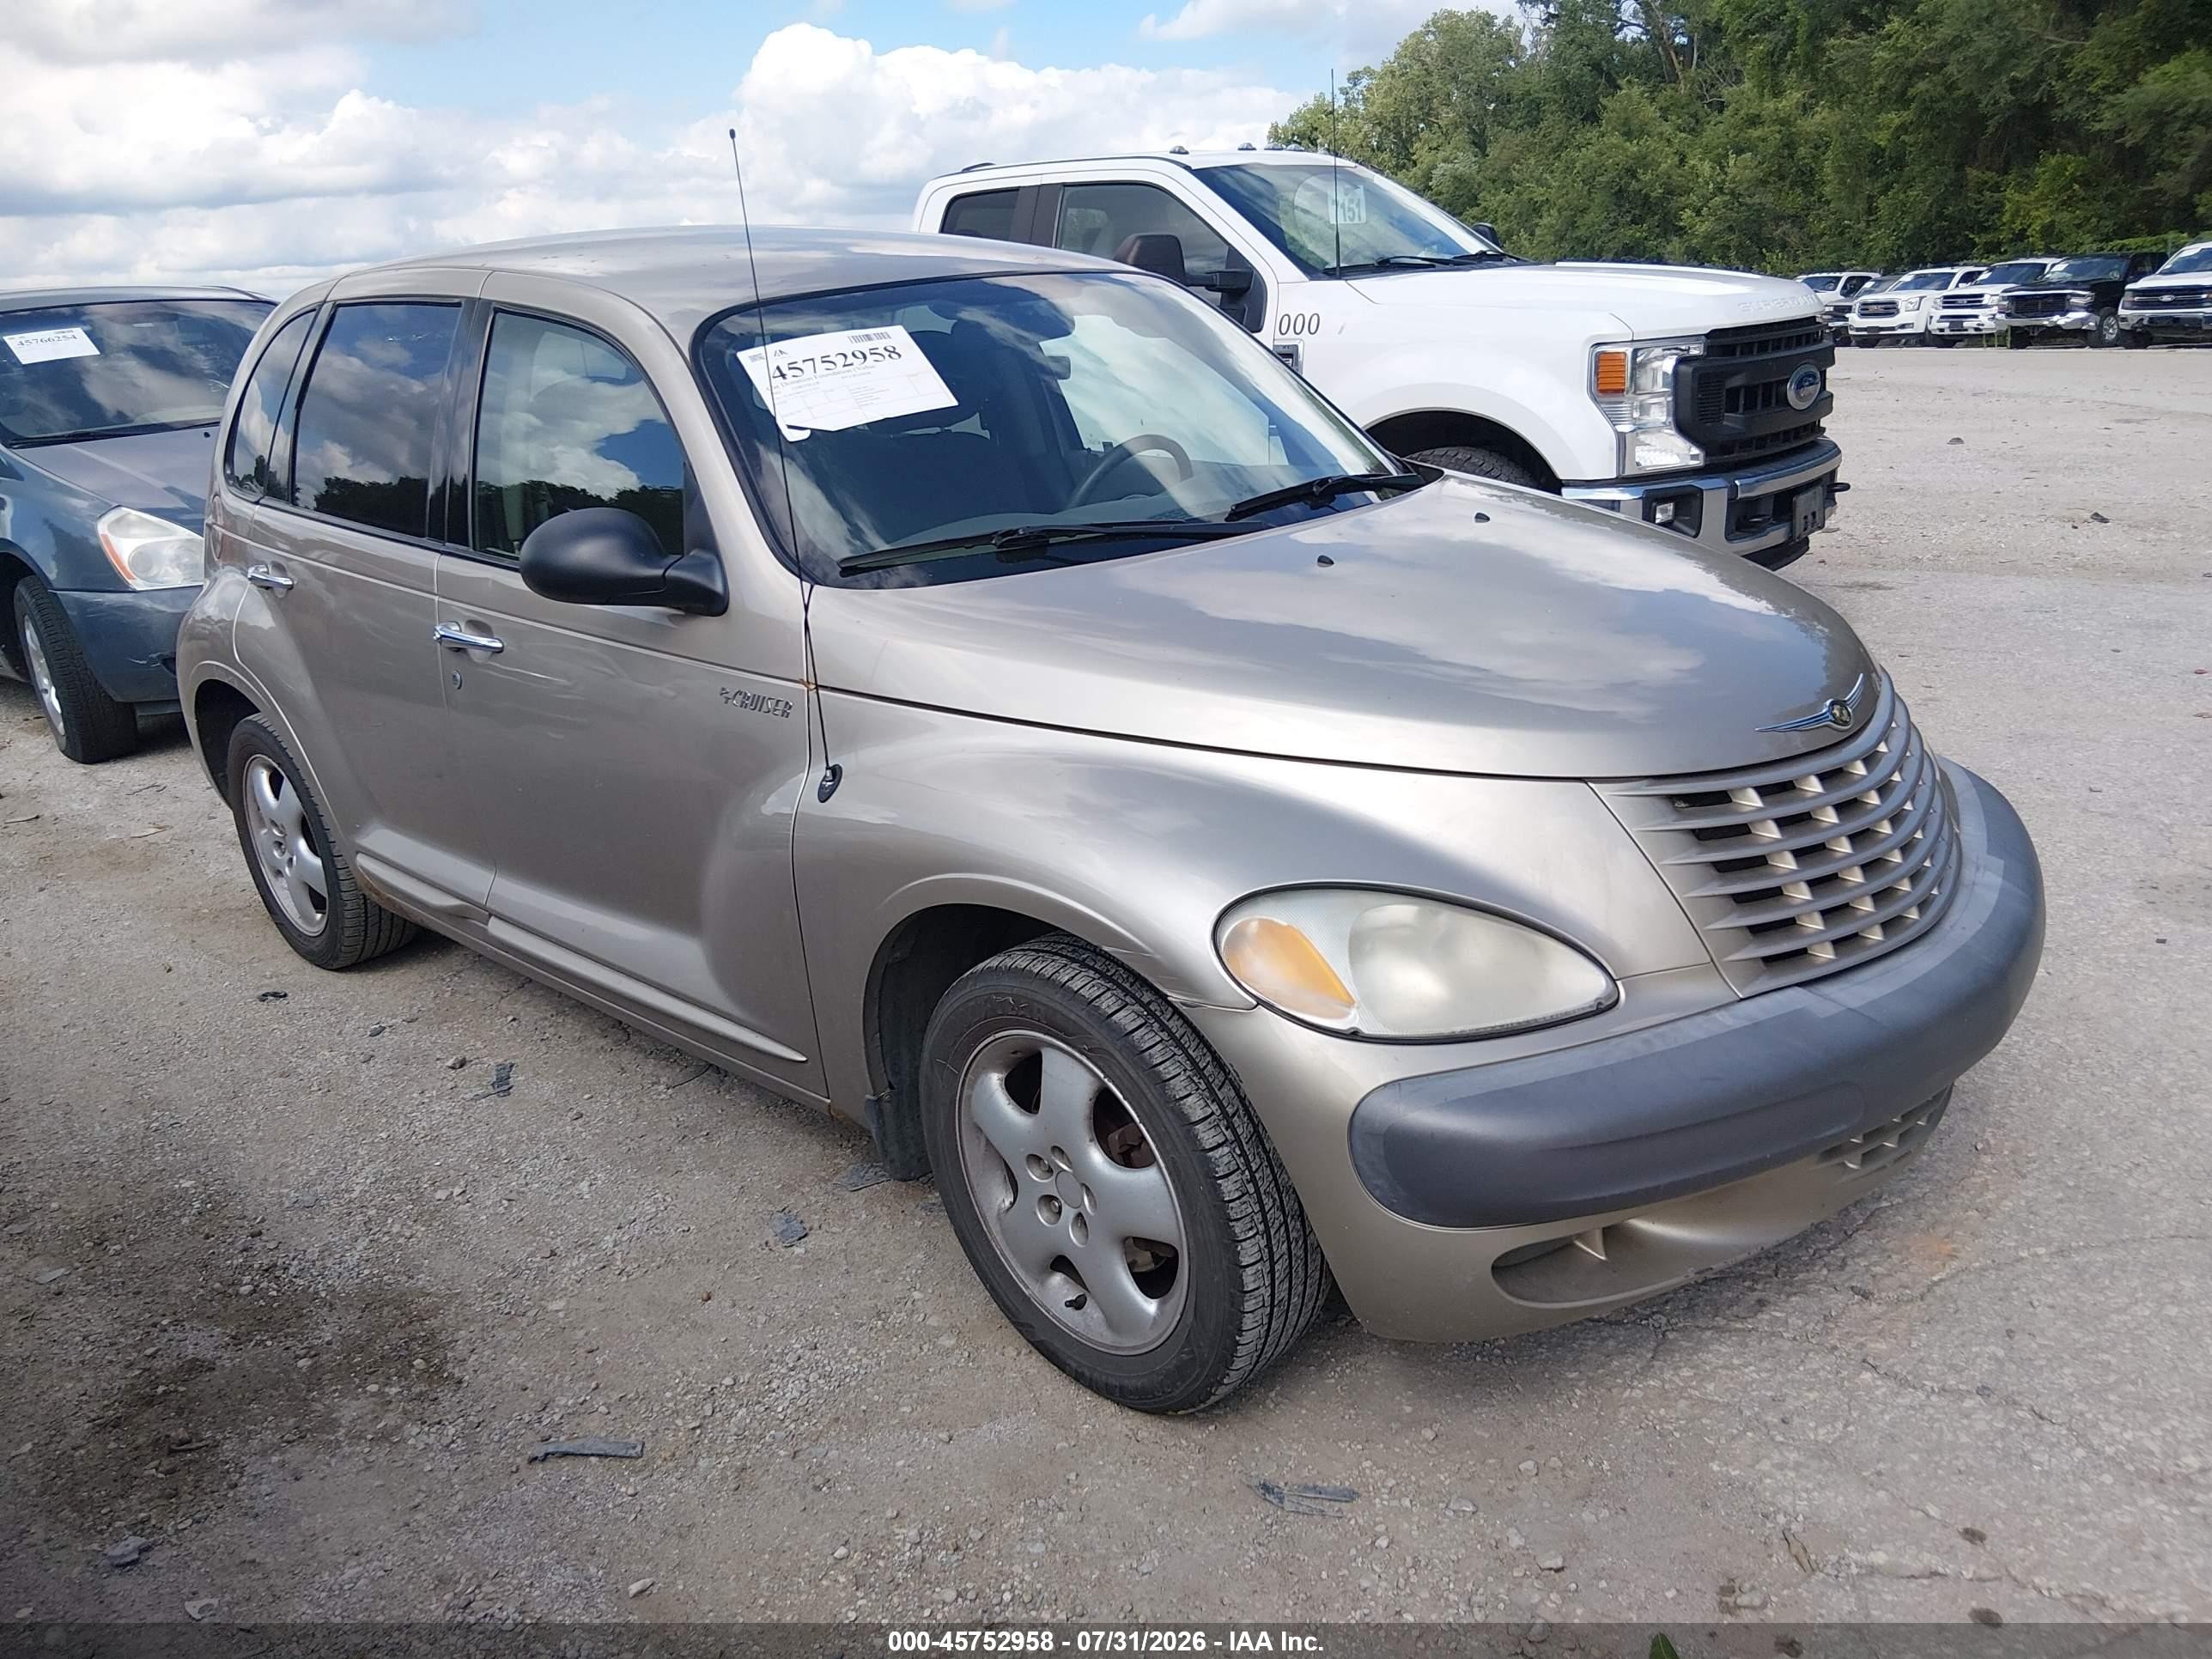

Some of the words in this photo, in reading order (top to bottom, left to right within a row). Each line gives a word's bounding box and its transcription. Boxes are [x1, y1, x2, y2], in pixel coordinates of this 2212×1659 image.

[1279, 313, 1321, 336] 000
[17, 334, 77, 346] 45766254
[772, 345, 902, 380] 45752958
[732, 690, 793, 718] CRUISER
